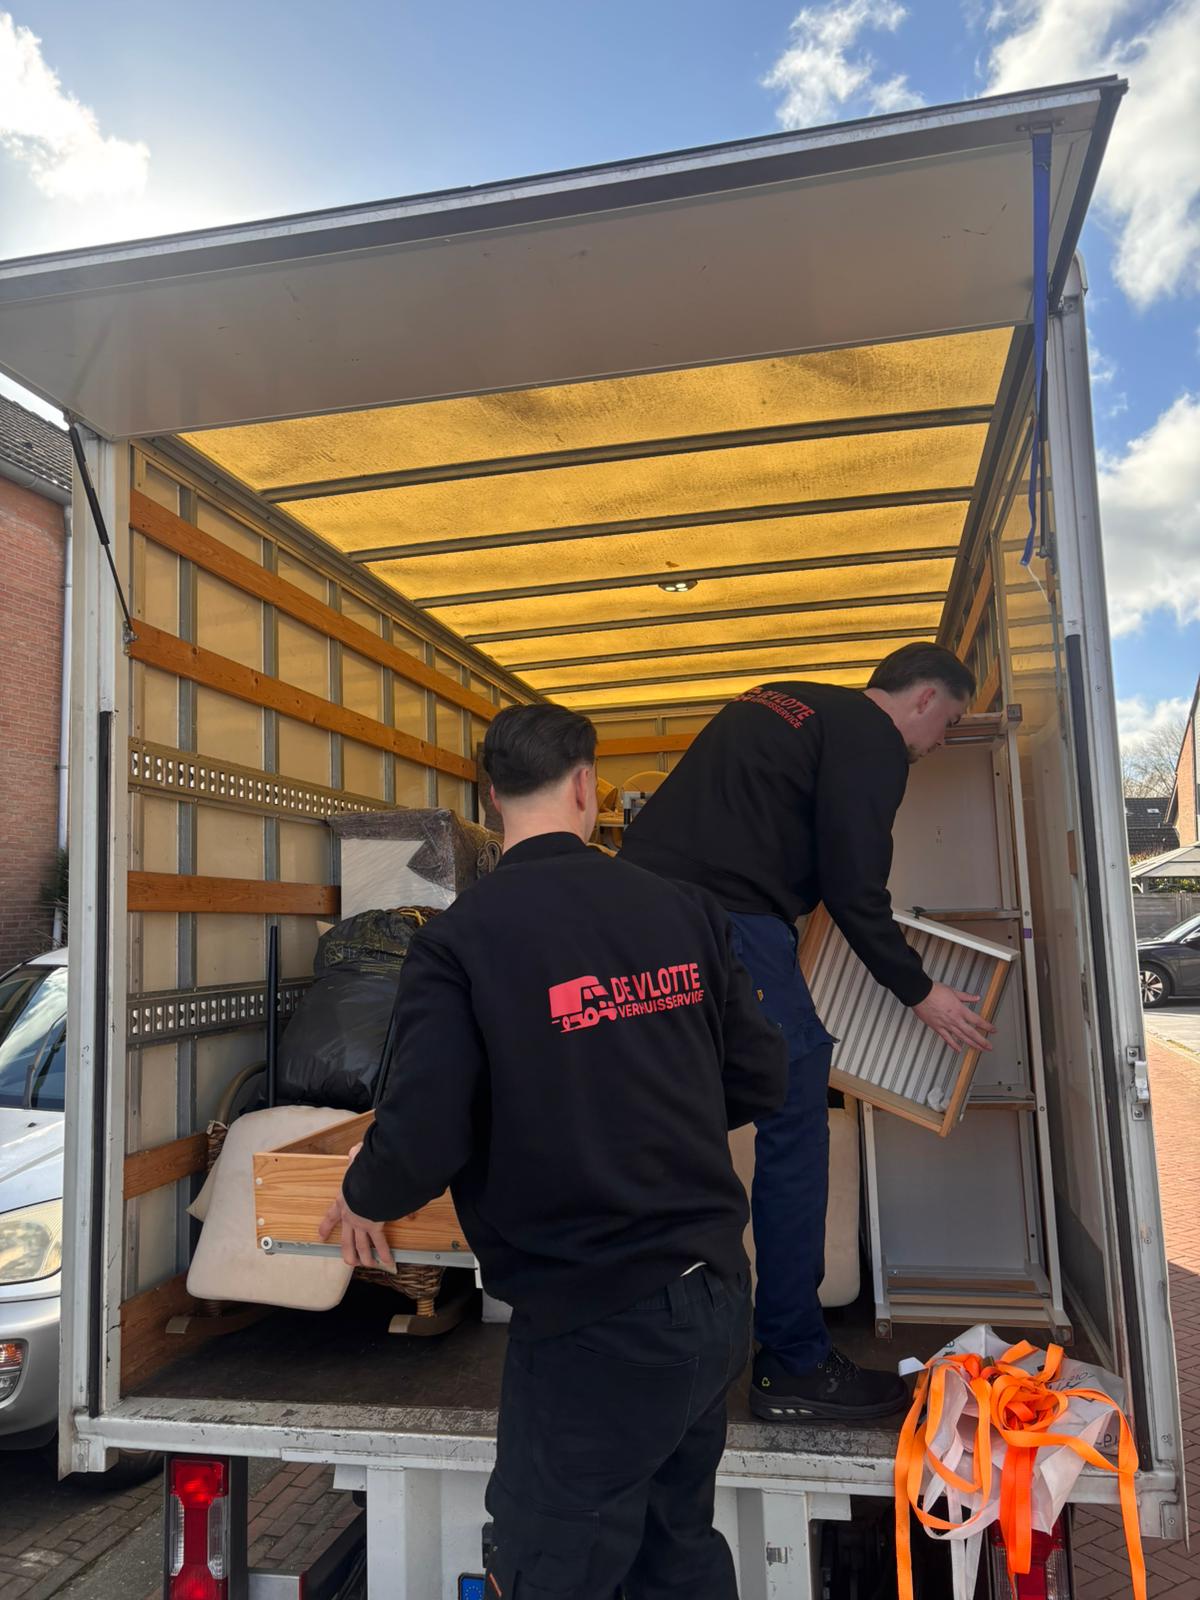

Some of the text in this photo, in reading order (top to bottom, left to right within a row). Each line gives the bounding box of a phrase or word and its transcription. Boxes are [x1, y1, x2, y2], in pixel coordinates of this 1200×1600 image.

[610, 963, 700, 1004] DE VLOTTE
[617, 989, 704, 1018] VERHUISSERVICE
